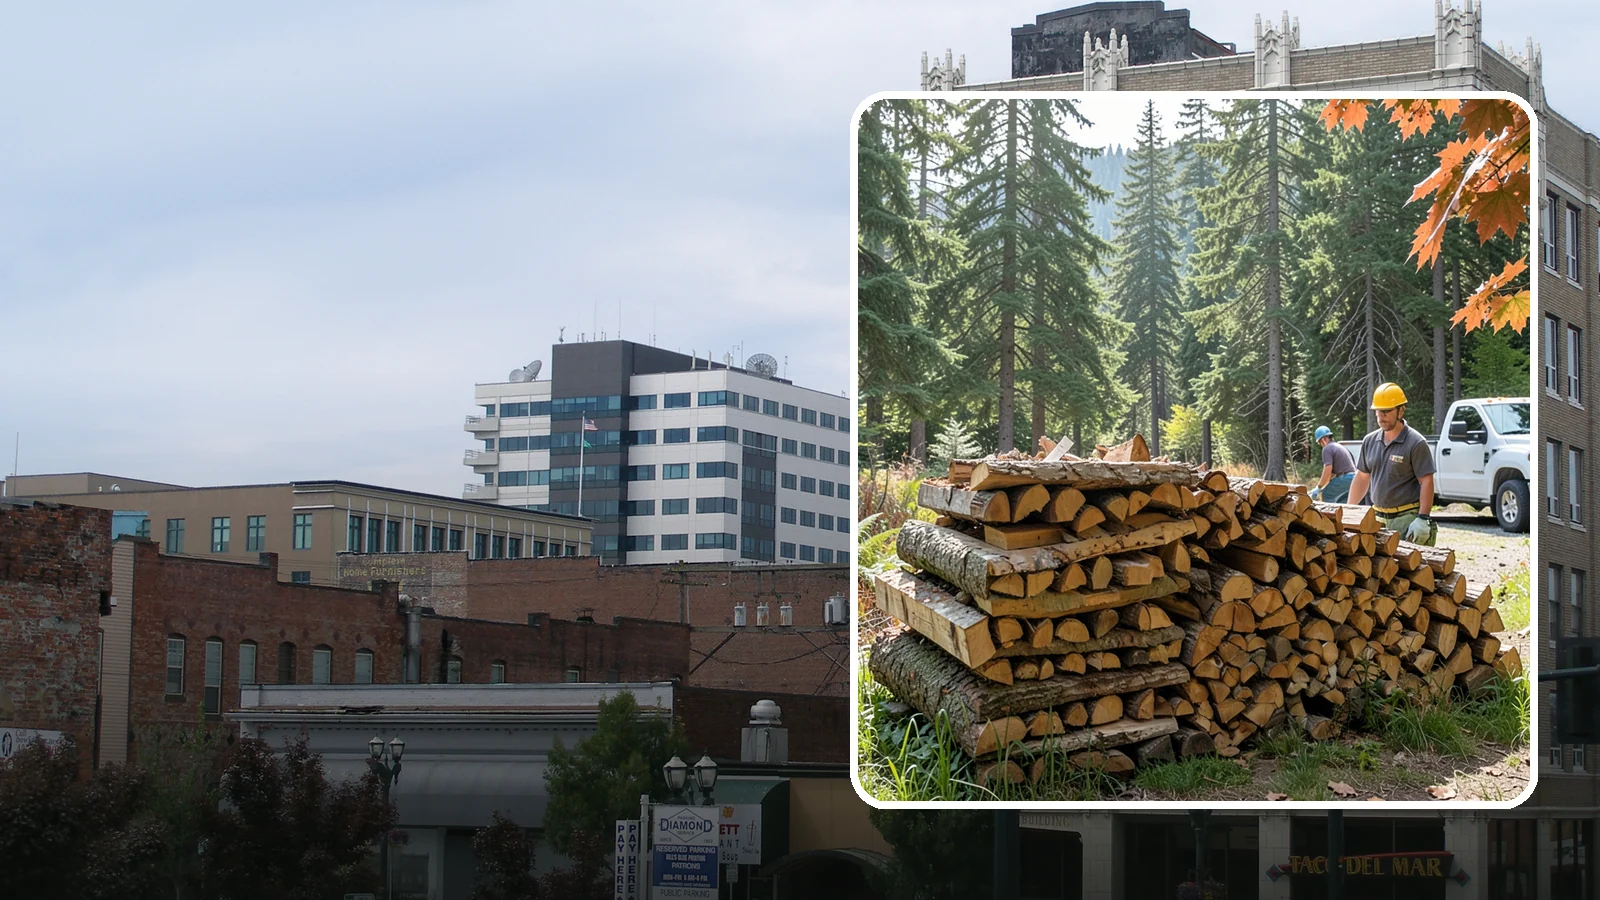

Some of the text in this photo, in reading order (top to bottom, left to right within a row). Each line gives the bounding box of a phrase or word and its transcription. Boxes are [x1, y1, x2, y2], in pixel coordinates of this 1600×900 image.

[343, 566, 427, 577] Home Furnishers
[660, 818, 713, 832] DIAMOND
[1022, 815, 1069, 827] BUILDING
[616, 825, 625, 894] PAY HERE
[627, 825, 636, 894] PAY HERE
[1290, 855, 1442, 877] TAC DEL MAR
[683, 889, 710, 898] PARKING
